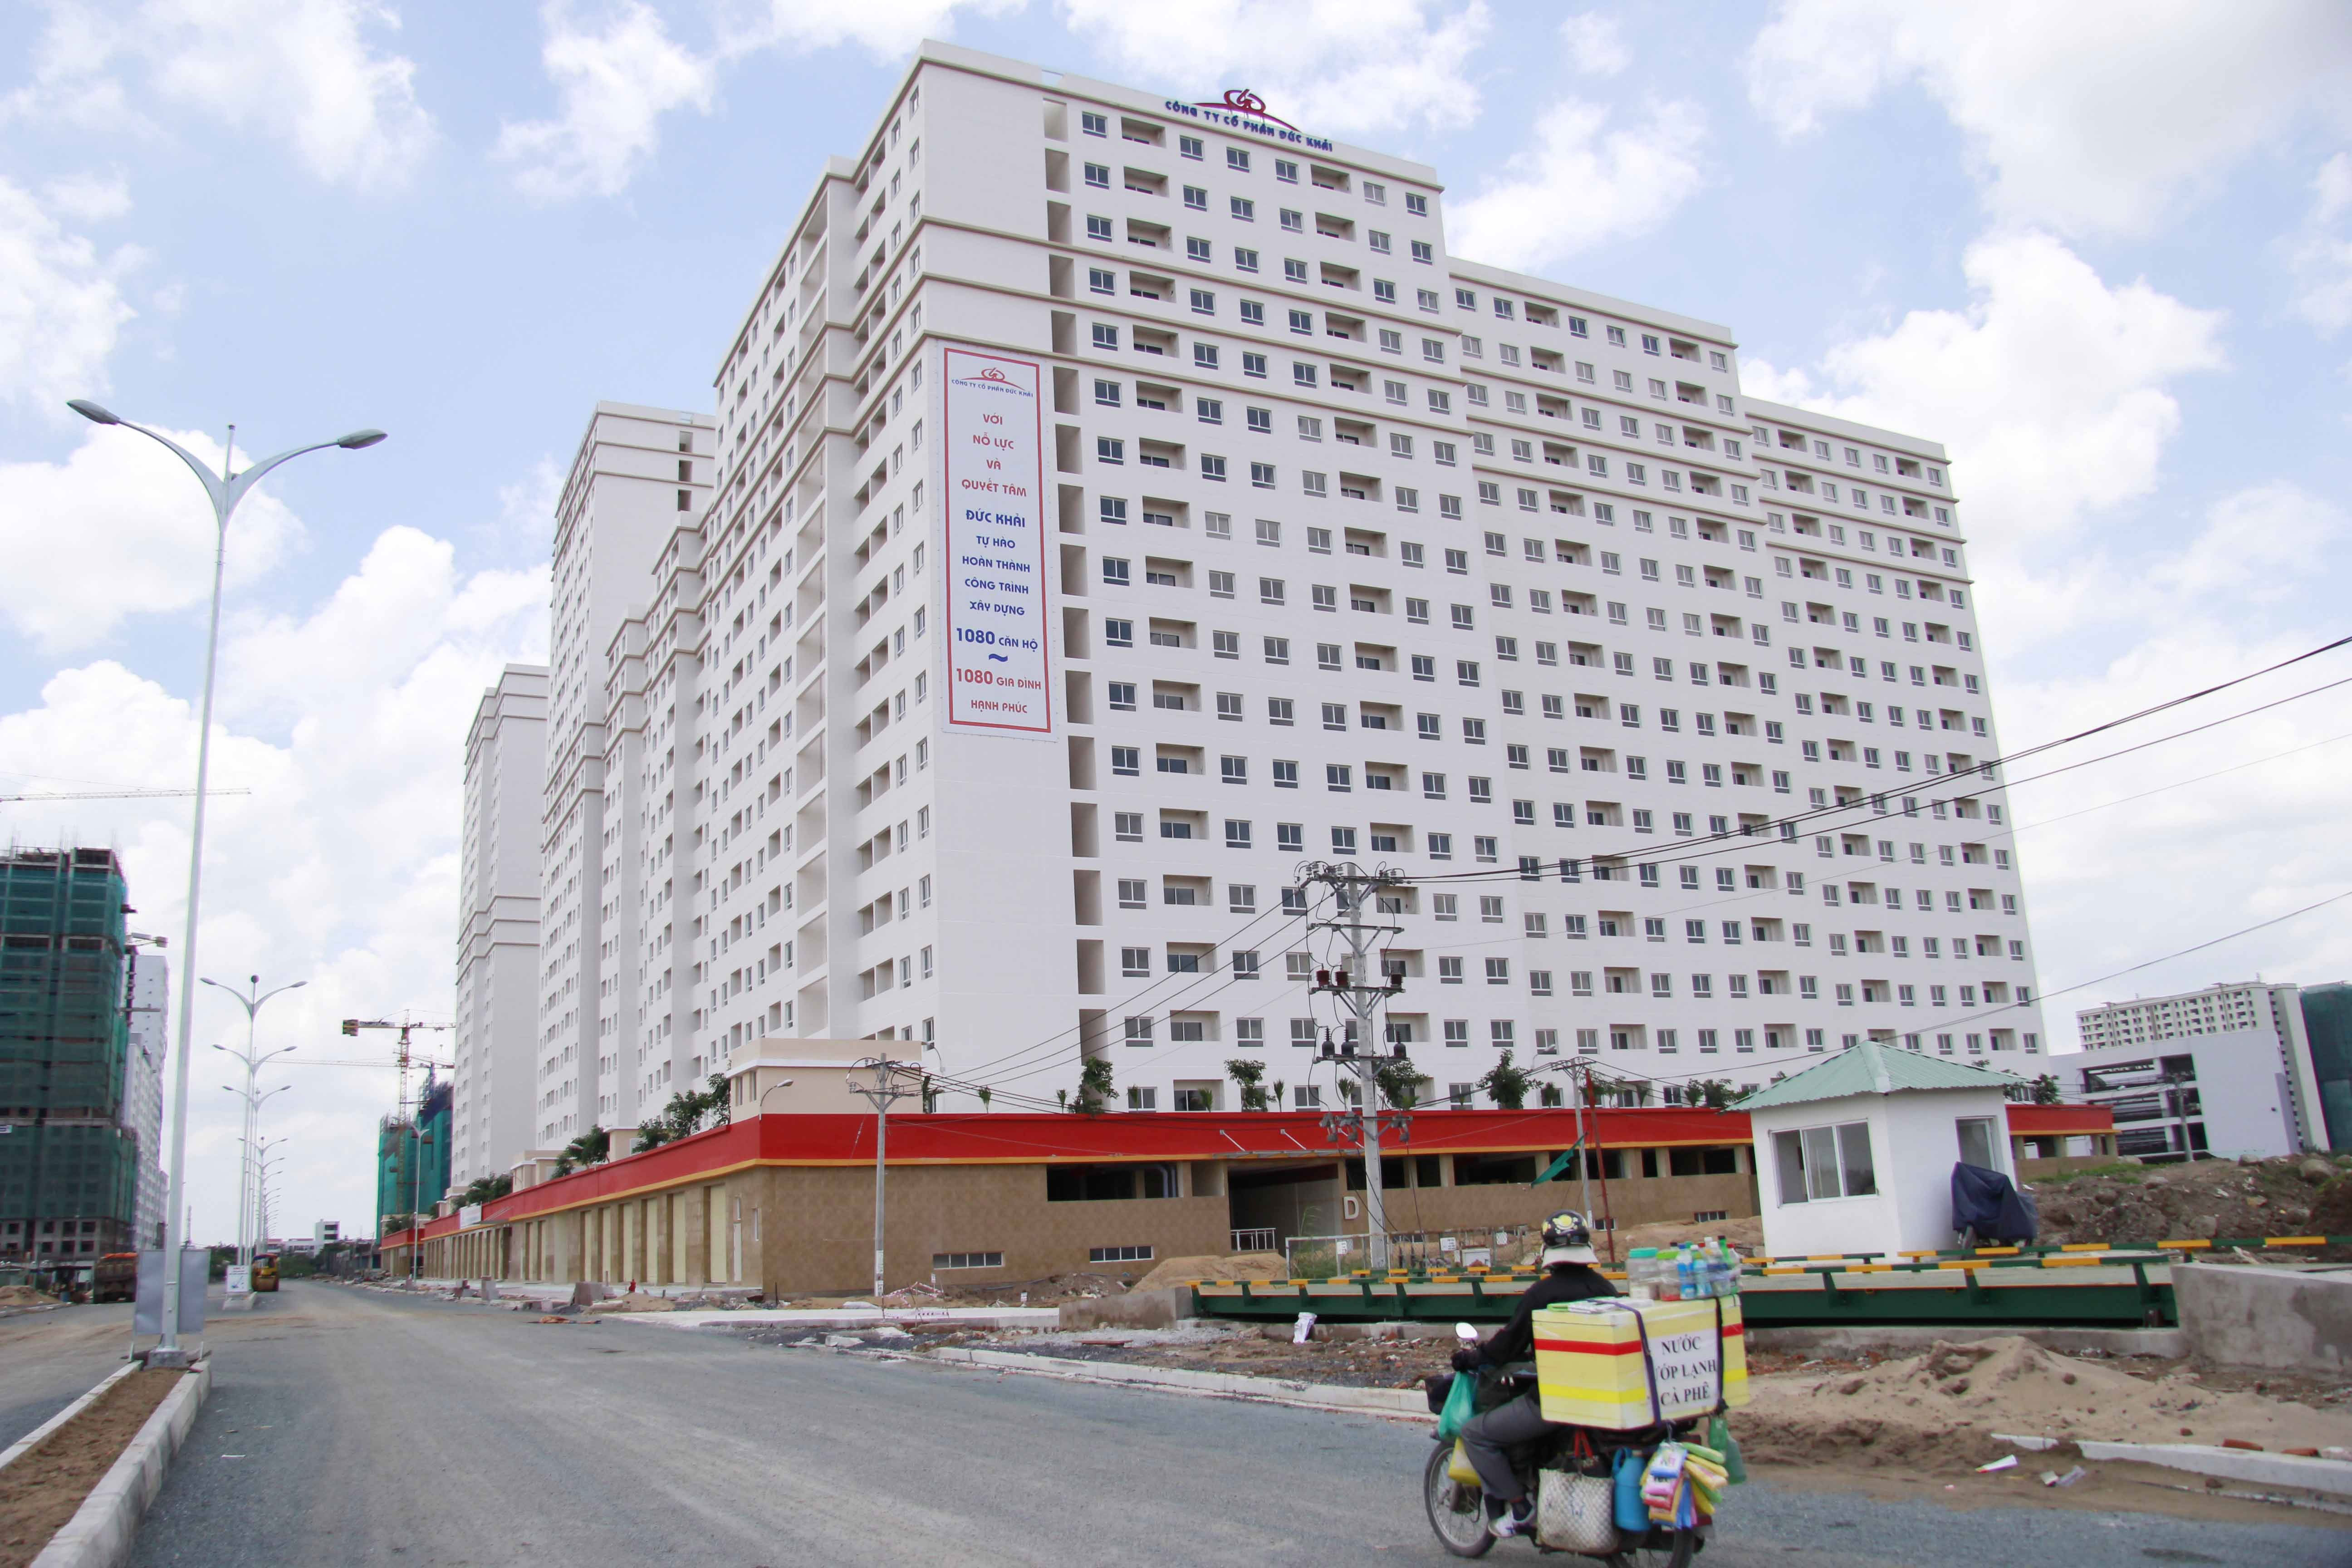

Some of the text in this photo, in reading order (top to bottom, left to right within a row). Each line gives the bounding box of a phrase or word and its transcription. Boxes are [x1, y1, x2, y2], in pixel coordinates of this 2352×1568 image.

[1204, 111, 1220, 122] TY
[983, 412, 1003, 425] VỚI
[973, 432, 1014, 451] NỖ LỰC
[986, 457, 1001, 470] VÀ
[961, 478, 1027, 496] QUYẾT TÂM
[965, 508, 1025, 527] ĐỨC KHẢI
[976, 534, 1015, 549] TỰ HÀO
[962, 555, 1030, 573] HOÀN THÀNH
[965, 577, 1029, 594] CÔNG TRÌNH
[970, 600, 1025, 616] XÂY DỰNG
[956, 628, 1038, 652] 1080 CĂN HỘ
[956, 668, 1041, 690] 1080 GIA ĐÌNH
[971, 700, 1027, 713] HẠNH PHÚC
[1343, 1196, 1359, 1219] D
[1661, 1333, 1701, 1355] NƯỚC
[1682, 1359, 1717, 1379] LẠNH
[1661, 1381, 1710, 1406] CÀ PHÊ
